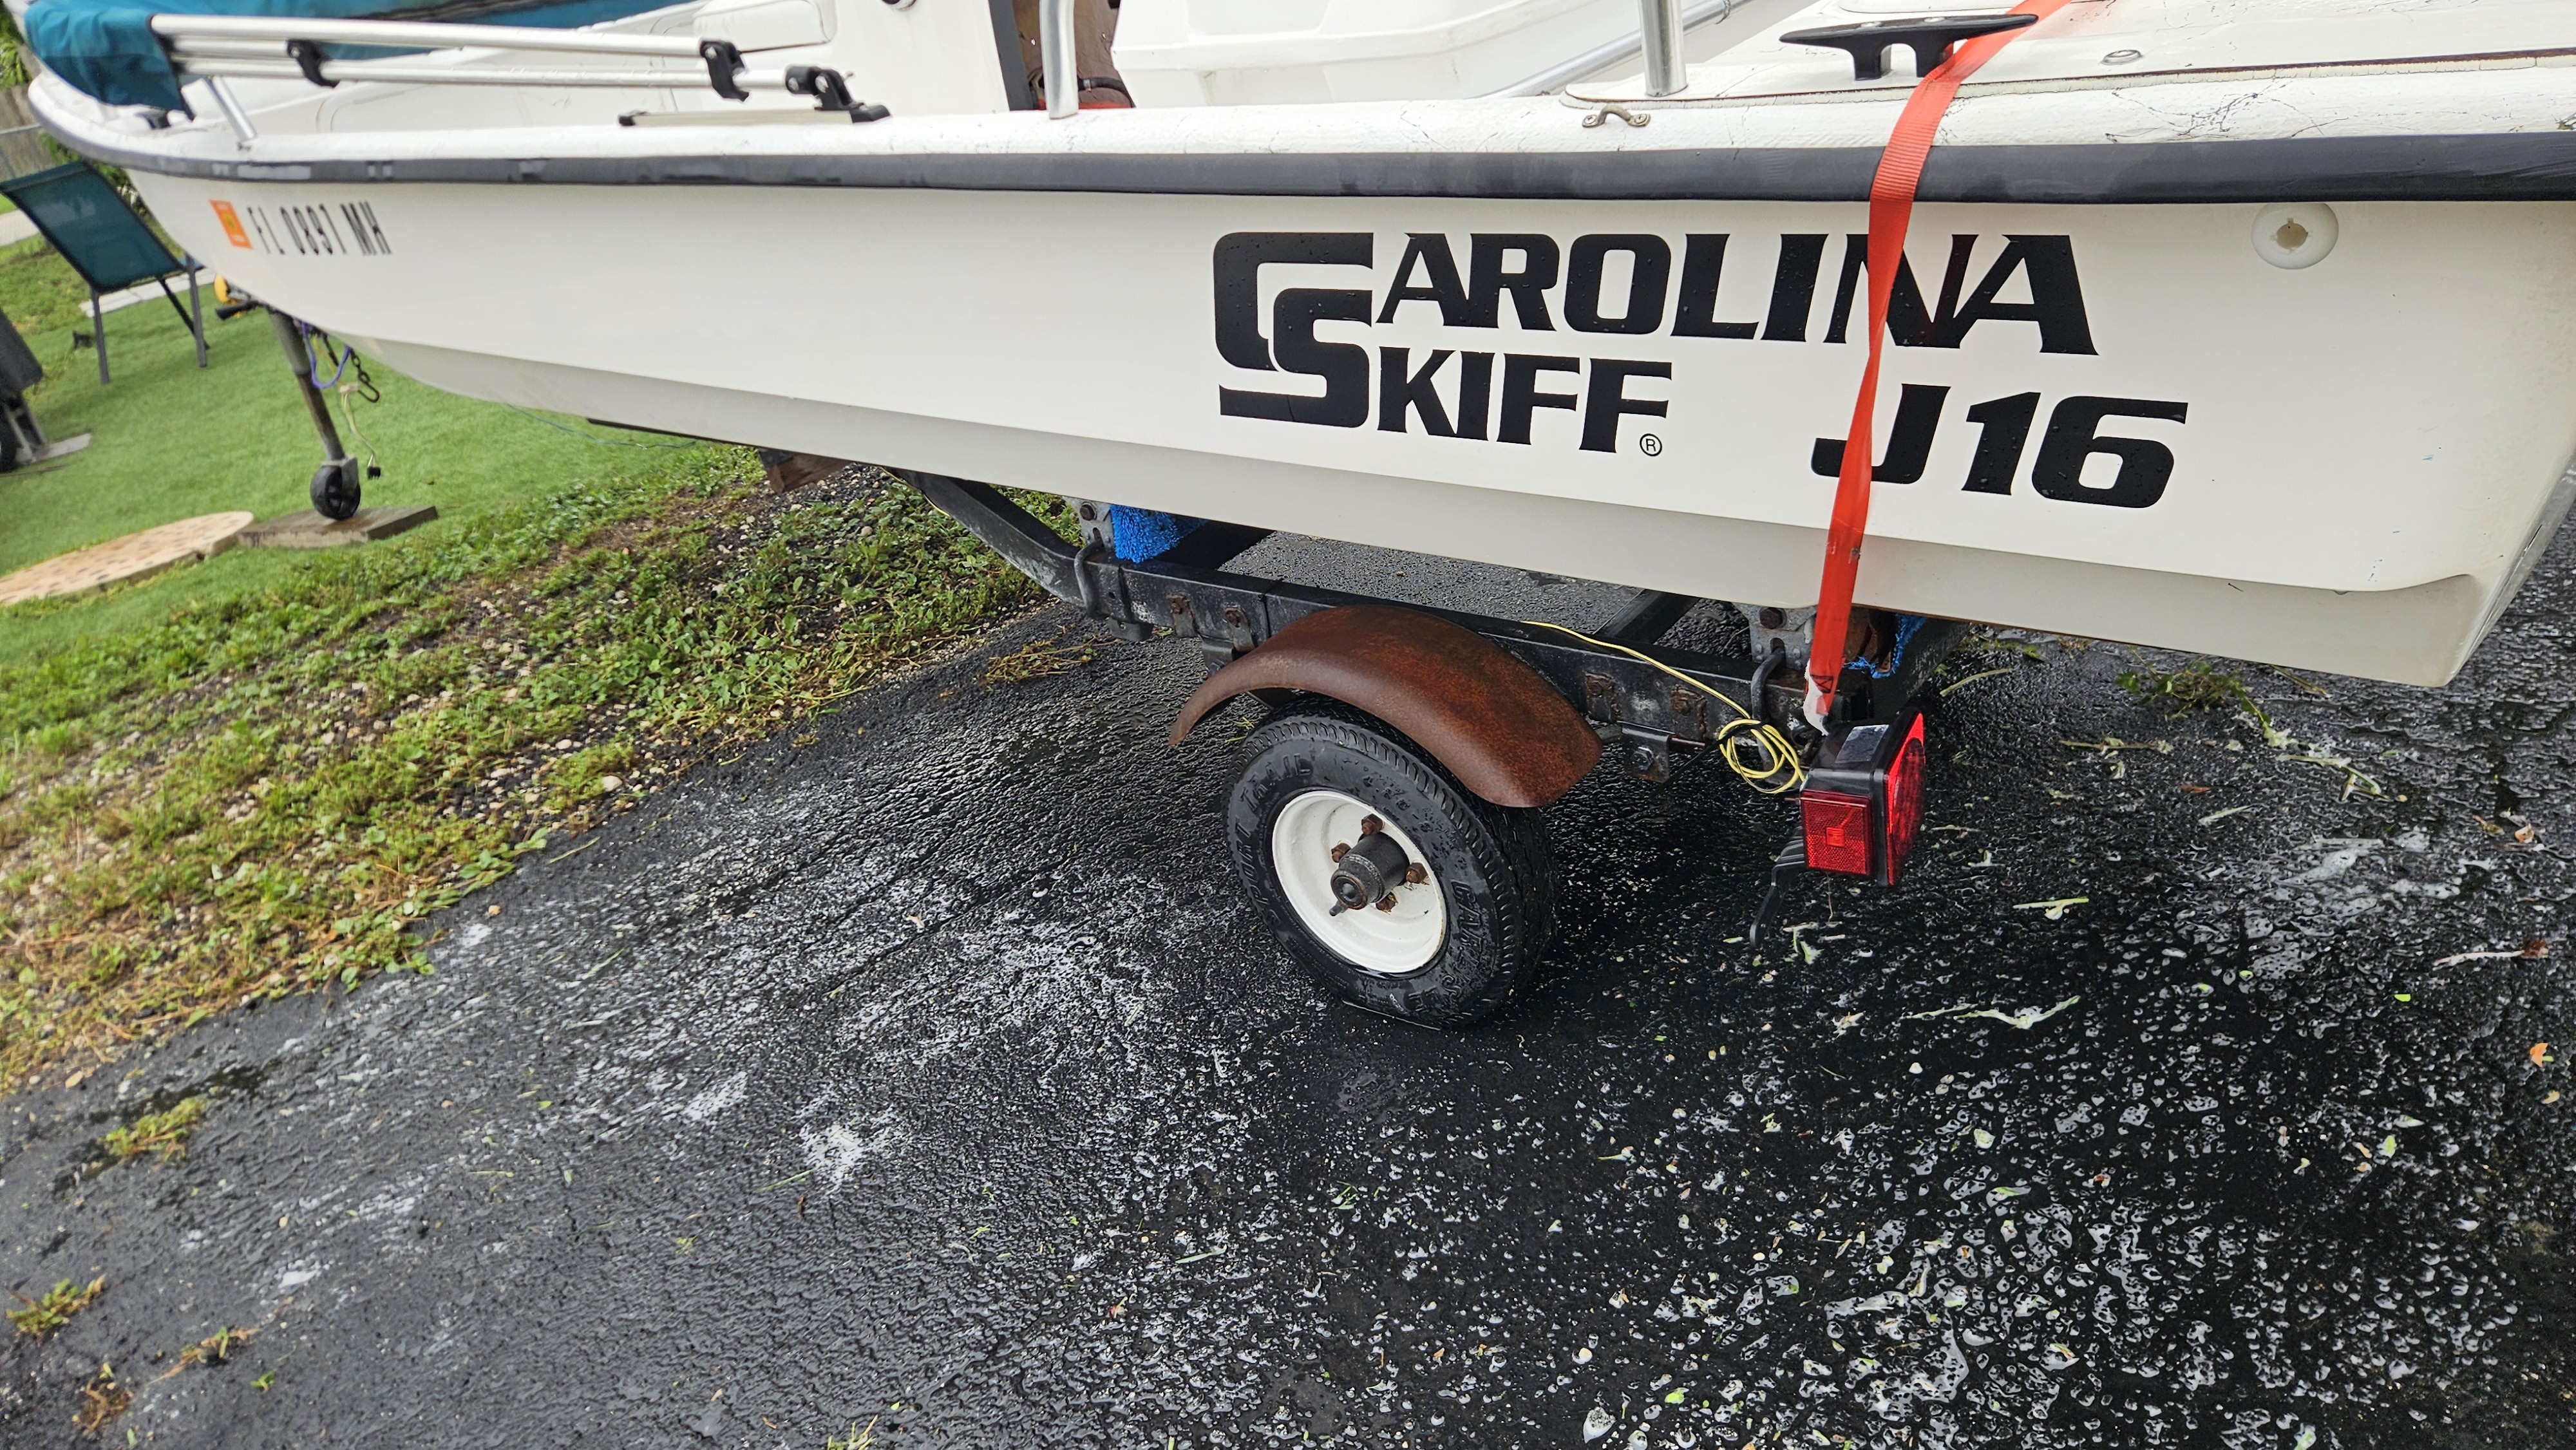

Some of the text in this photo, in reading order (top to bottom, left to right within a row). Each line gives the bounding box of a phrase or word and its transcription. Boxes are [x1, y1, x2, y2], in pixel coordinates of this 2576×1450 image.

[247, 200, 392, 256] FL 0891 MH
[1213, 232, 2098, 372] CAROLINA
[1219, 288, 1672, 453] SKIFF
[1811, 383, 2188, 509] J16
[1235, 753, 1312, 927] SPORT TRAIL
